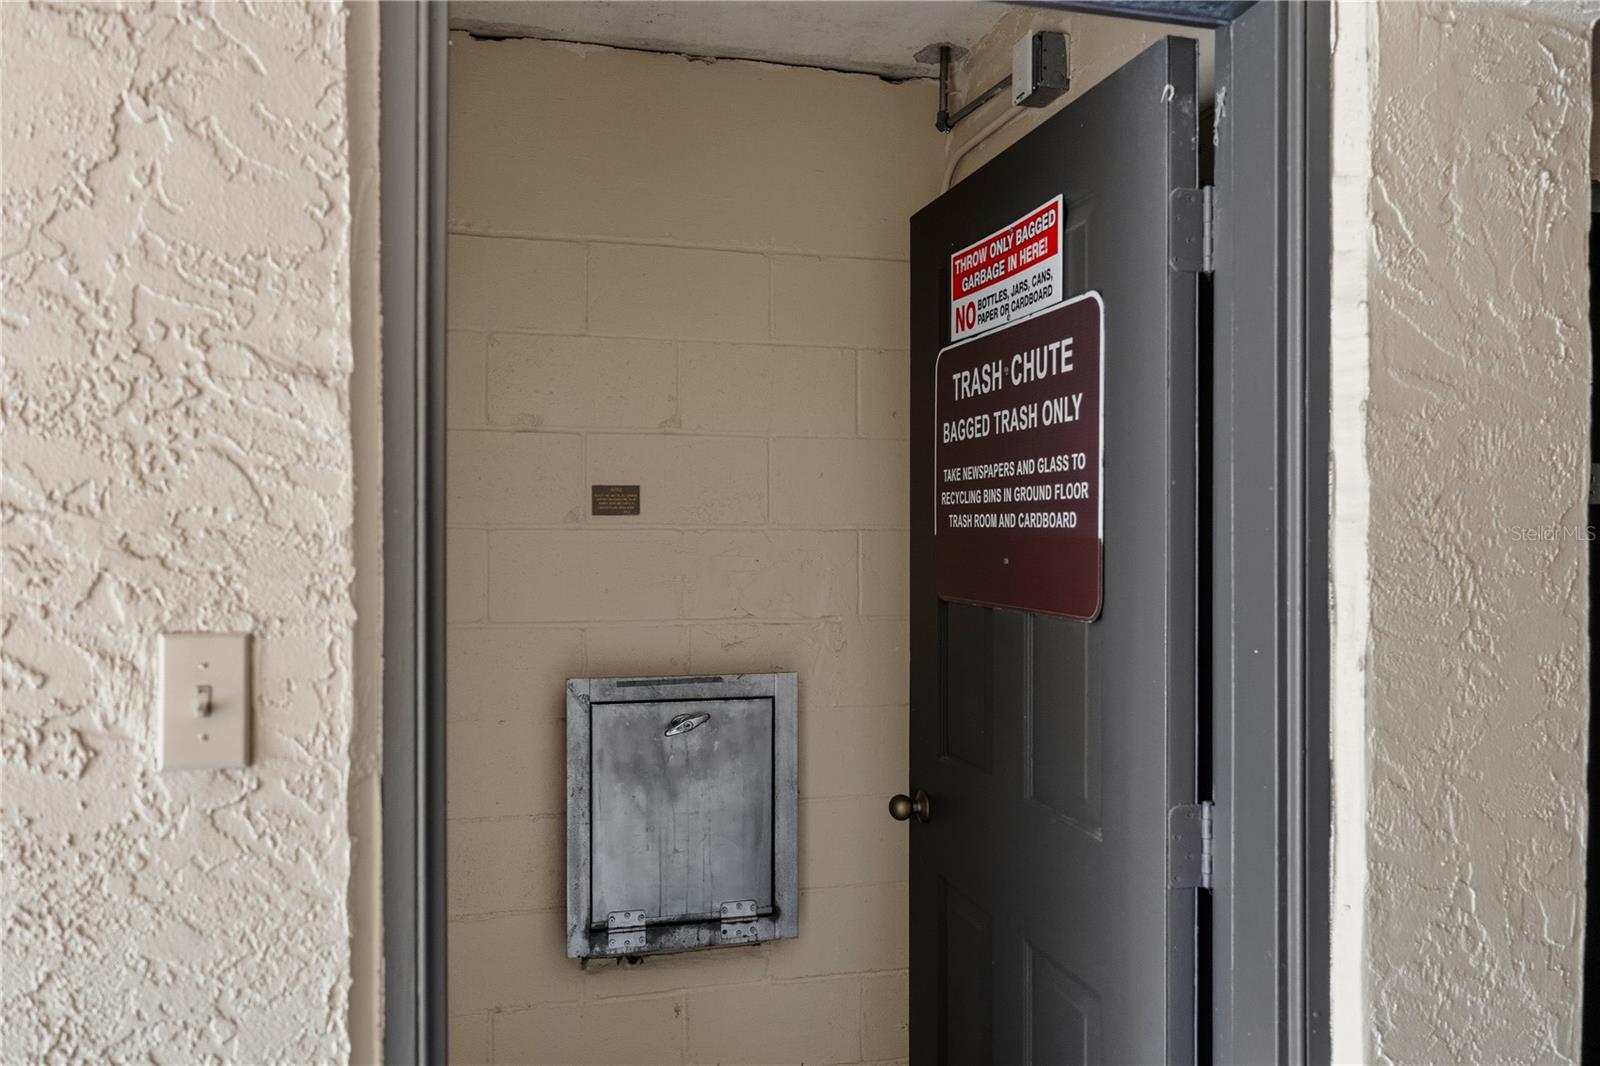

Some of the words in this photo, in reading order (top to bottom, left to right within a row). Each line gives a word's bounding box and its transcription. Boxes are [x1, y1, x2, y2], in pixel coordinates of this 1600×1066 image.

[955, 246, 987, 275] THROW
[990, 233, 1013, 259] ONLY
[1016, 208, 1056, 246] BAGGED
[962, 262, 1005, 292] GARBAGE
[1008, 253, 1016, 271] IN
[1019, 237, 1048, 265] HERE!
[977, 288, 1009, 311] BOTTLES,
[1011, 279, 1030, 297] JARS,
[1032, 268, 1053, 288] CANS,
[977, 308, 998, 325] PAPER
[1000, 302, 1010, 316] OR
[1011, 284, 1053, 312] CARDBOARD
[955, 302, 976, 333] NO
[953, 360, 1003, 400] TRASH
[1011, 337, 1073, 386] CHUTE
[943, 412, 989, 444] BAGGED
[994, 403, 1037, 435] TRASH
[1042, 393, 1083, 426] ONLY
[944, 466, 960, 483] TAKE
[962, 460, 1014, 481] NEWSPAPERS
[1016, 458, 1035, 475] AND
[1037, 455, 1069, 474] GLASS
[1071, 452, 1086, 470] TO
[941, 488, 982, 505] RECYCLING
[983, 488, 1002, 503] BINS
[1003, 487, 1012, 502] IN
[1014, 485, 1051, 502] GROUND
[1054, 481, 1089, 500] FLOOR
[949, 514, 972, 528] TRASH
[974, 513, 998, 528] ROOM
[999, 513, 1016, 528] AND
[1018, 511, 1077, 528] CARDBOARD
